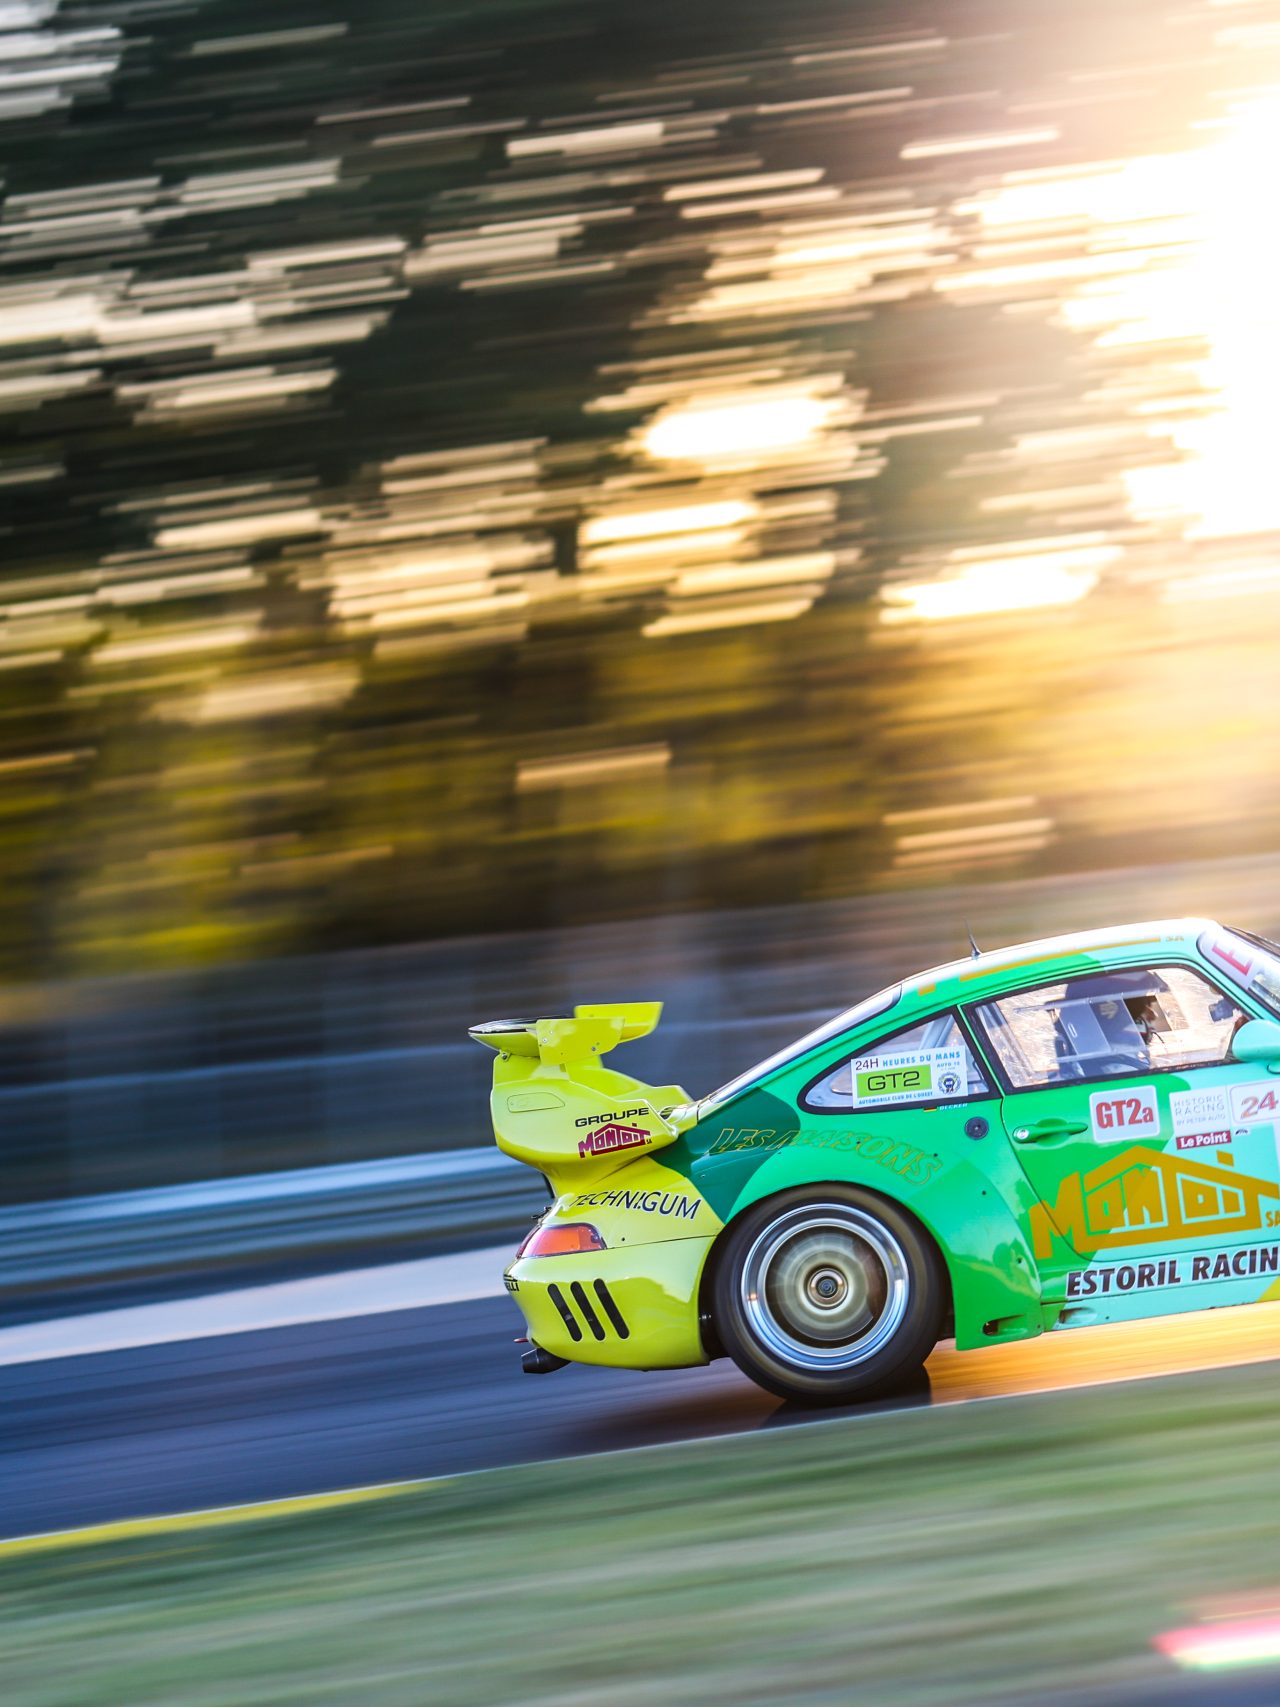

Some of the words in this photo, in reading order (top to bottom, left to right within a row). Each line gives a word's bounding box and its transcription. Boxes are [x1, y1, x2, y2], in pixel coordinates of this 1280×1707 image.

[855, 1058, 879, 1071] 24H
[882, 1056, 916, 1067] HEURES
[919, 1054, 932, 1062] DU
[935, 1051, 961, 1060] MANS
[867, 1070, 921, 1091] GT2
[1096, 1098, 1154, 1129] GT2a
[1175, 1103, 1225, 1116] RACING
[1240, 1090, 1279, 1120] 24
[575, 1107, 649, 1128] GROUPE
[1180, 1137, 1195, 1149] Le
[1196, 1132, 1228, 1146] Point
[1066, 1258, 1181, 1297] ESTORIL
